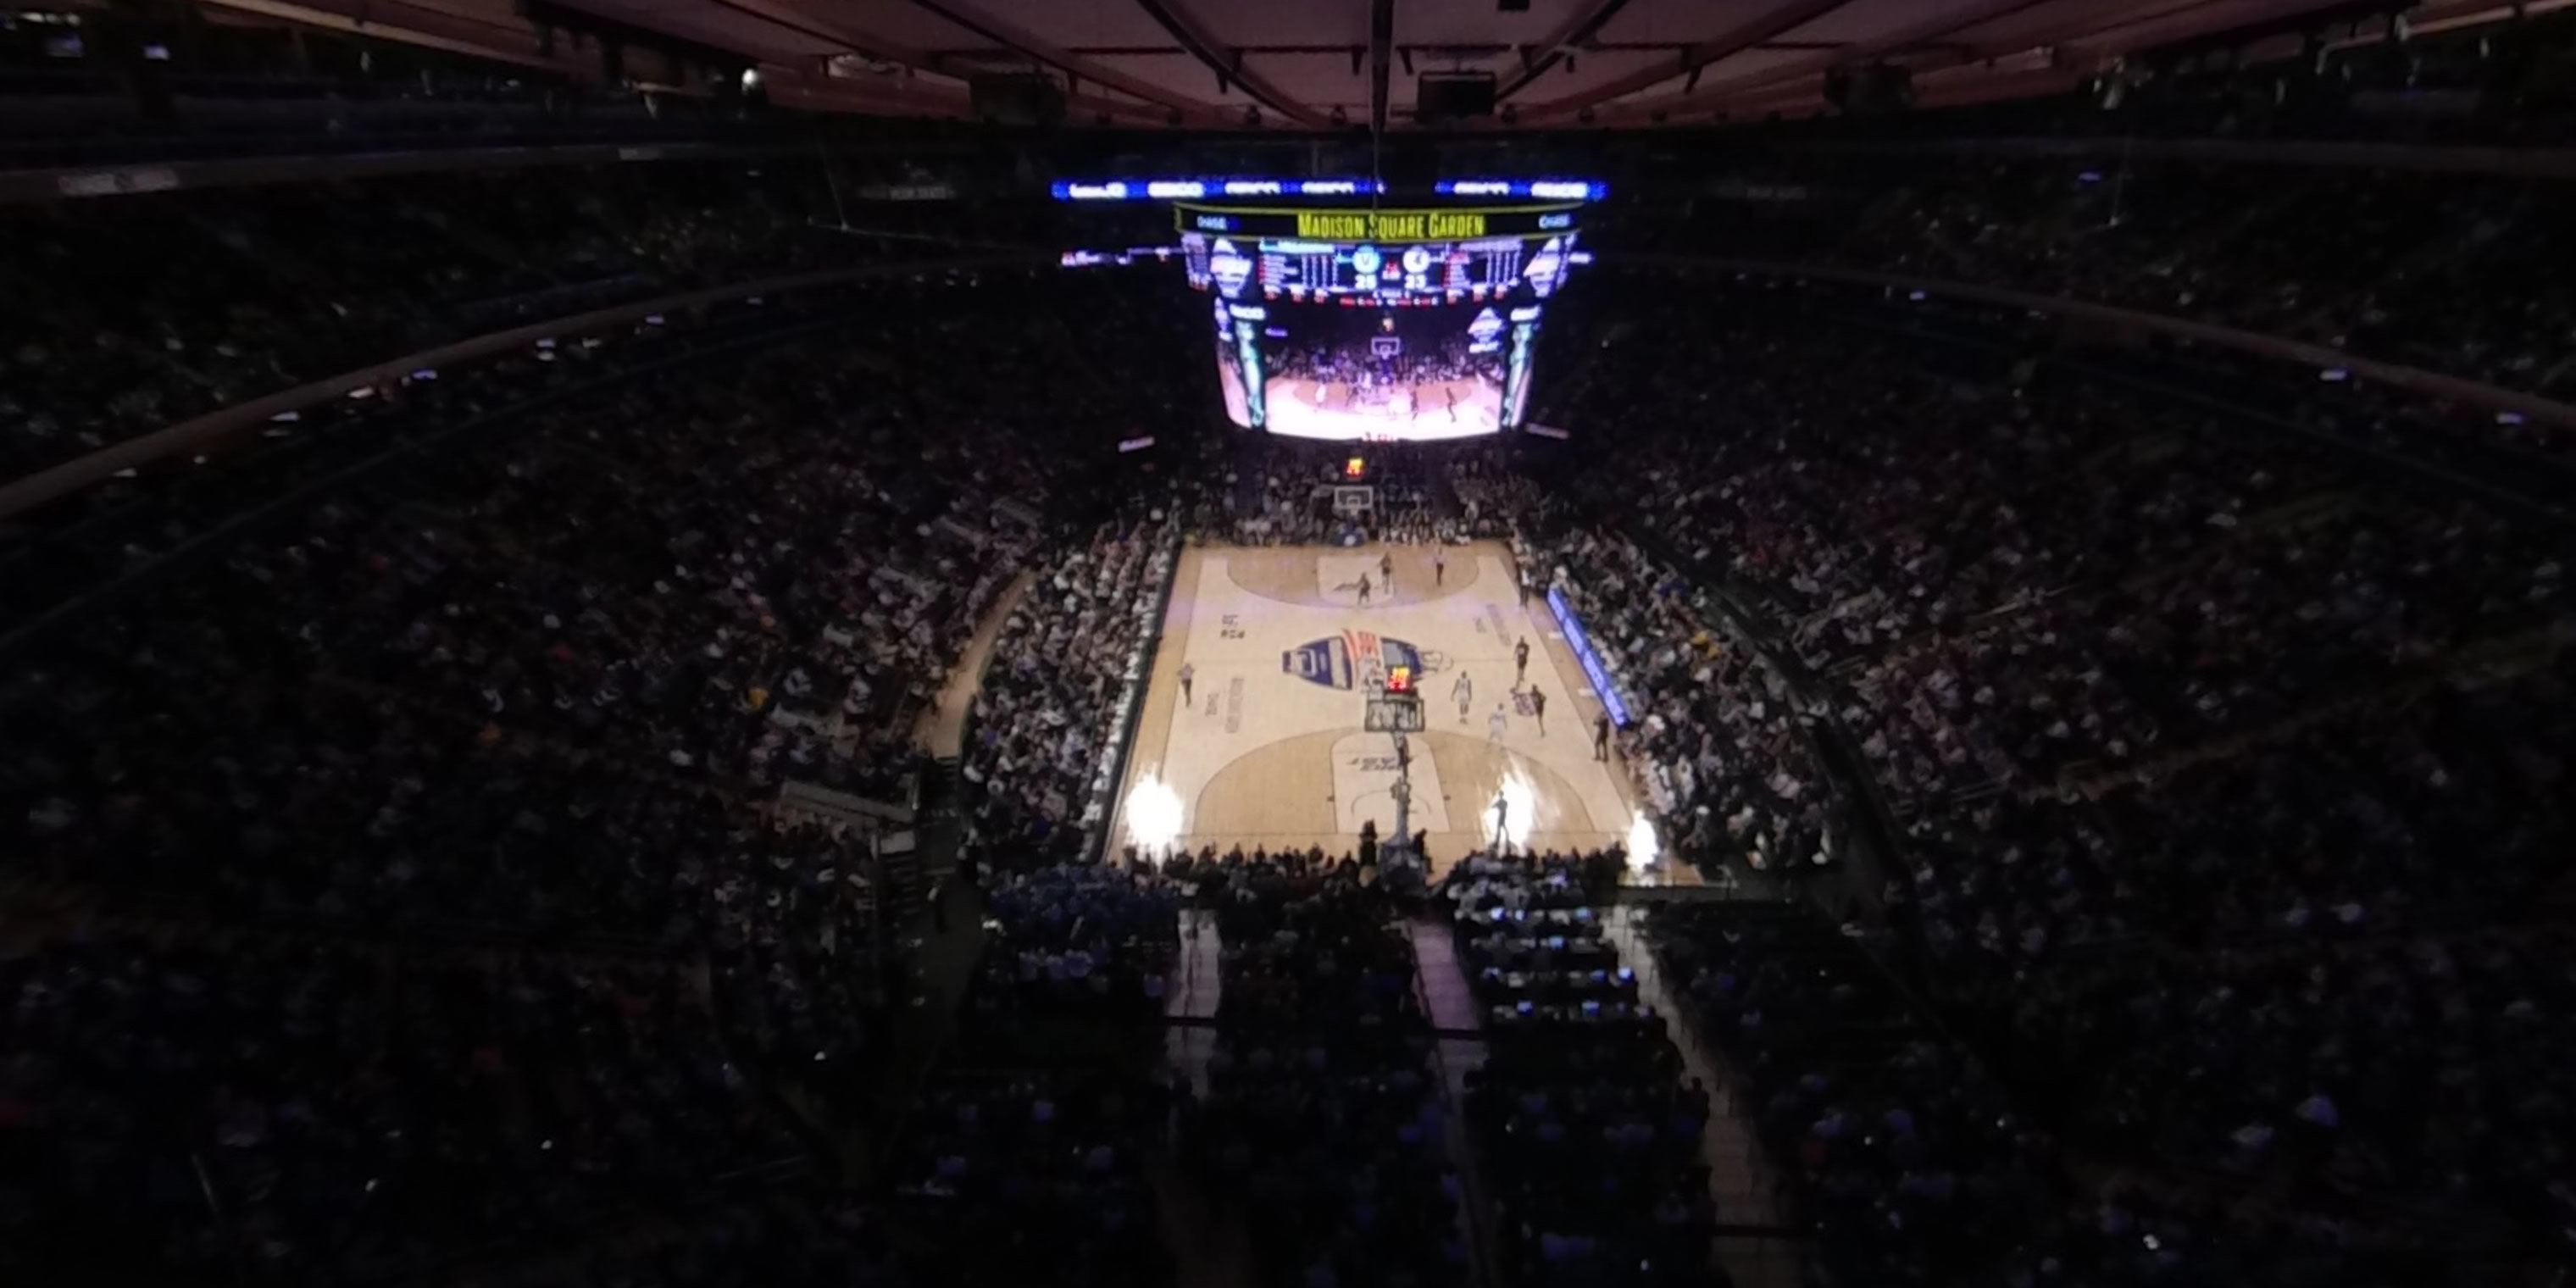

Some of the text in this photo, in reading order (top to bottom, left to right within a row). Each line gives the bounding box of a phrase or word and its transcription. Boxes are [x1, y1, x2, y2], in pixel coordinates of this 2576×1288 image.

[1298, 212, 1483, 239] MADISON SQUARE GARDEN
